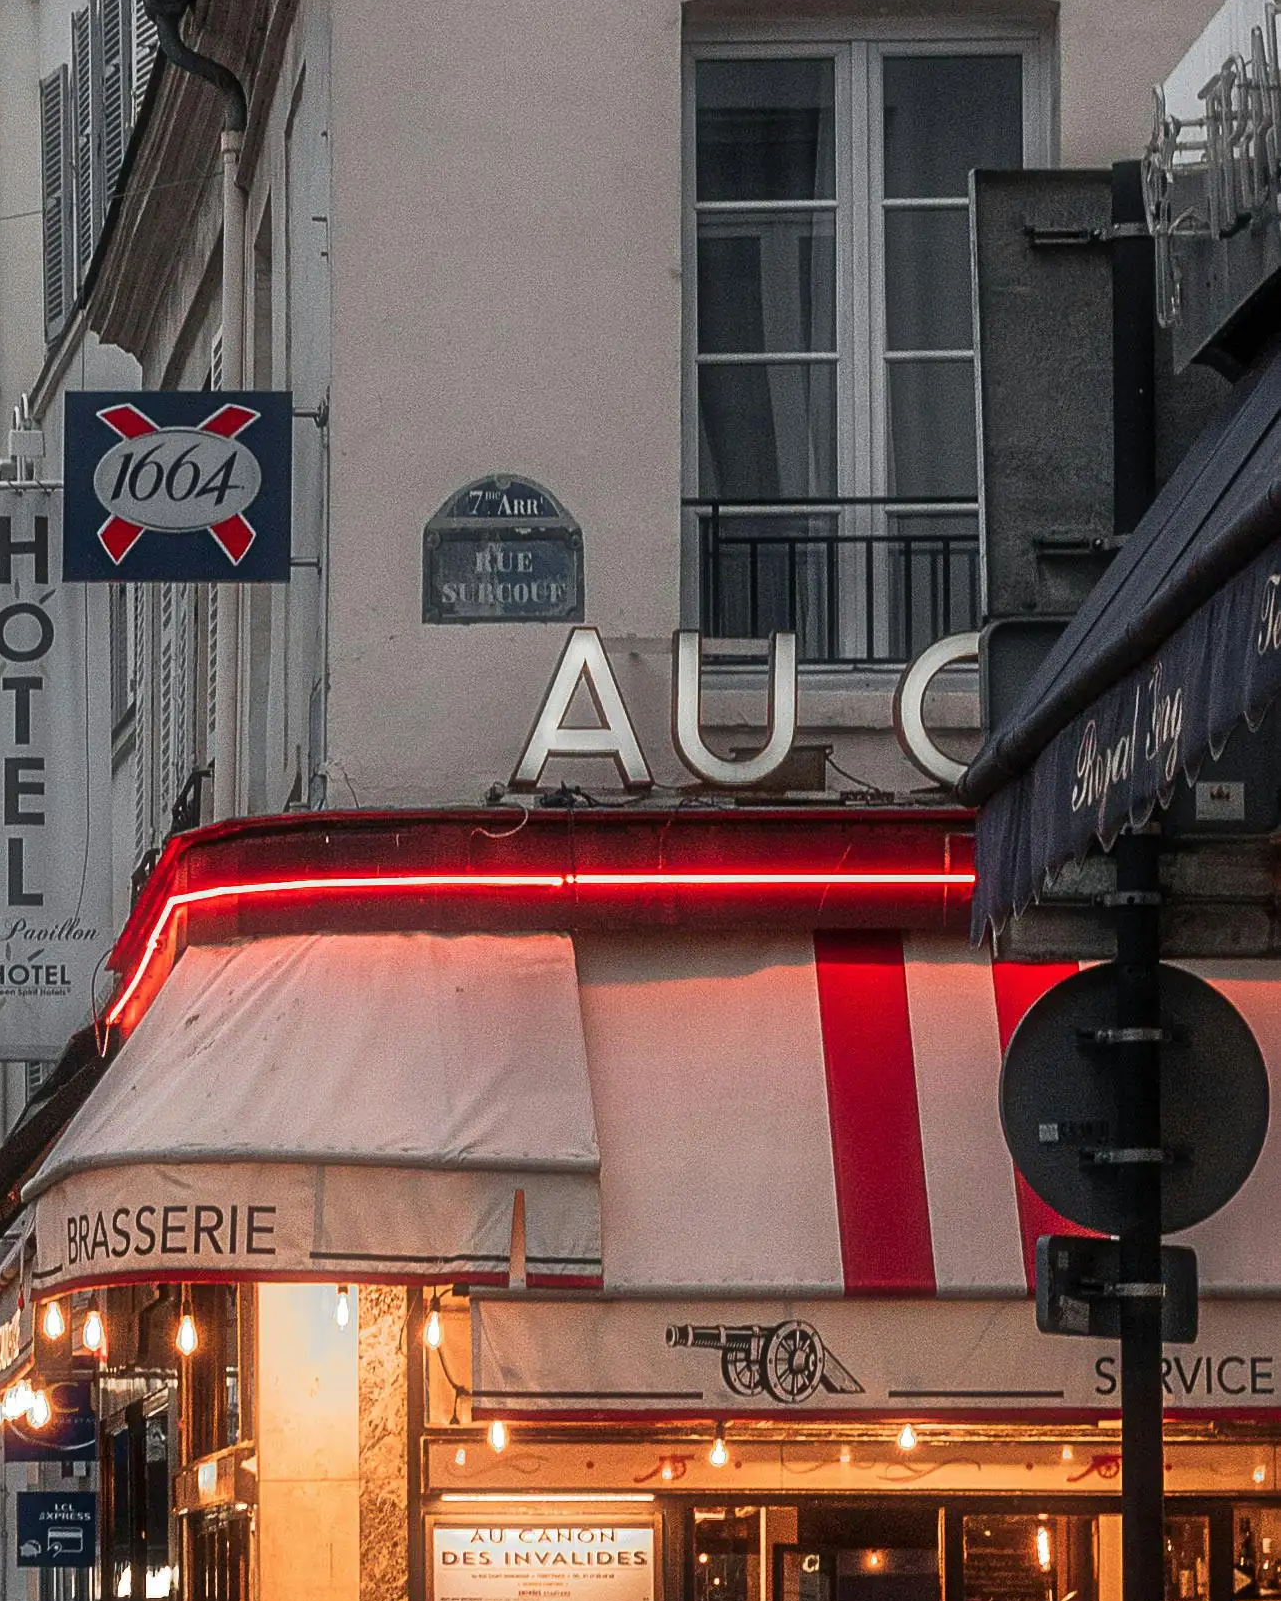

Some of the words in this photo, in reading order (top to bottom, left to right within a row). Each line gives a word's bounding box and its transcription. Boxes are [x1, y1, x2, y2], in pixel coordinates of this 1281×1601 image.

[111, 446, 240, 505] 1664
[475, 551, 533, 573] RUE
[442, 582, 566, 604] SURCOUF
[509, 627, 798, 793] AU
[18, 986, 38, 997] Spirit
[67, 1205, 277, 1266] BRASSERIE
[1095, 1355, 1275, 1396] SRVICE
[38, 1511, 92, 1522] EXPRESS
[54, 1502, 75, 1513] LCL
[470, 1528, 504, 1544] AU
[518, 1528, 616, 1544] CANON
[441, 1550, 493, 1567] DES
[505, 1550, 649, 1567] INVALIDES
